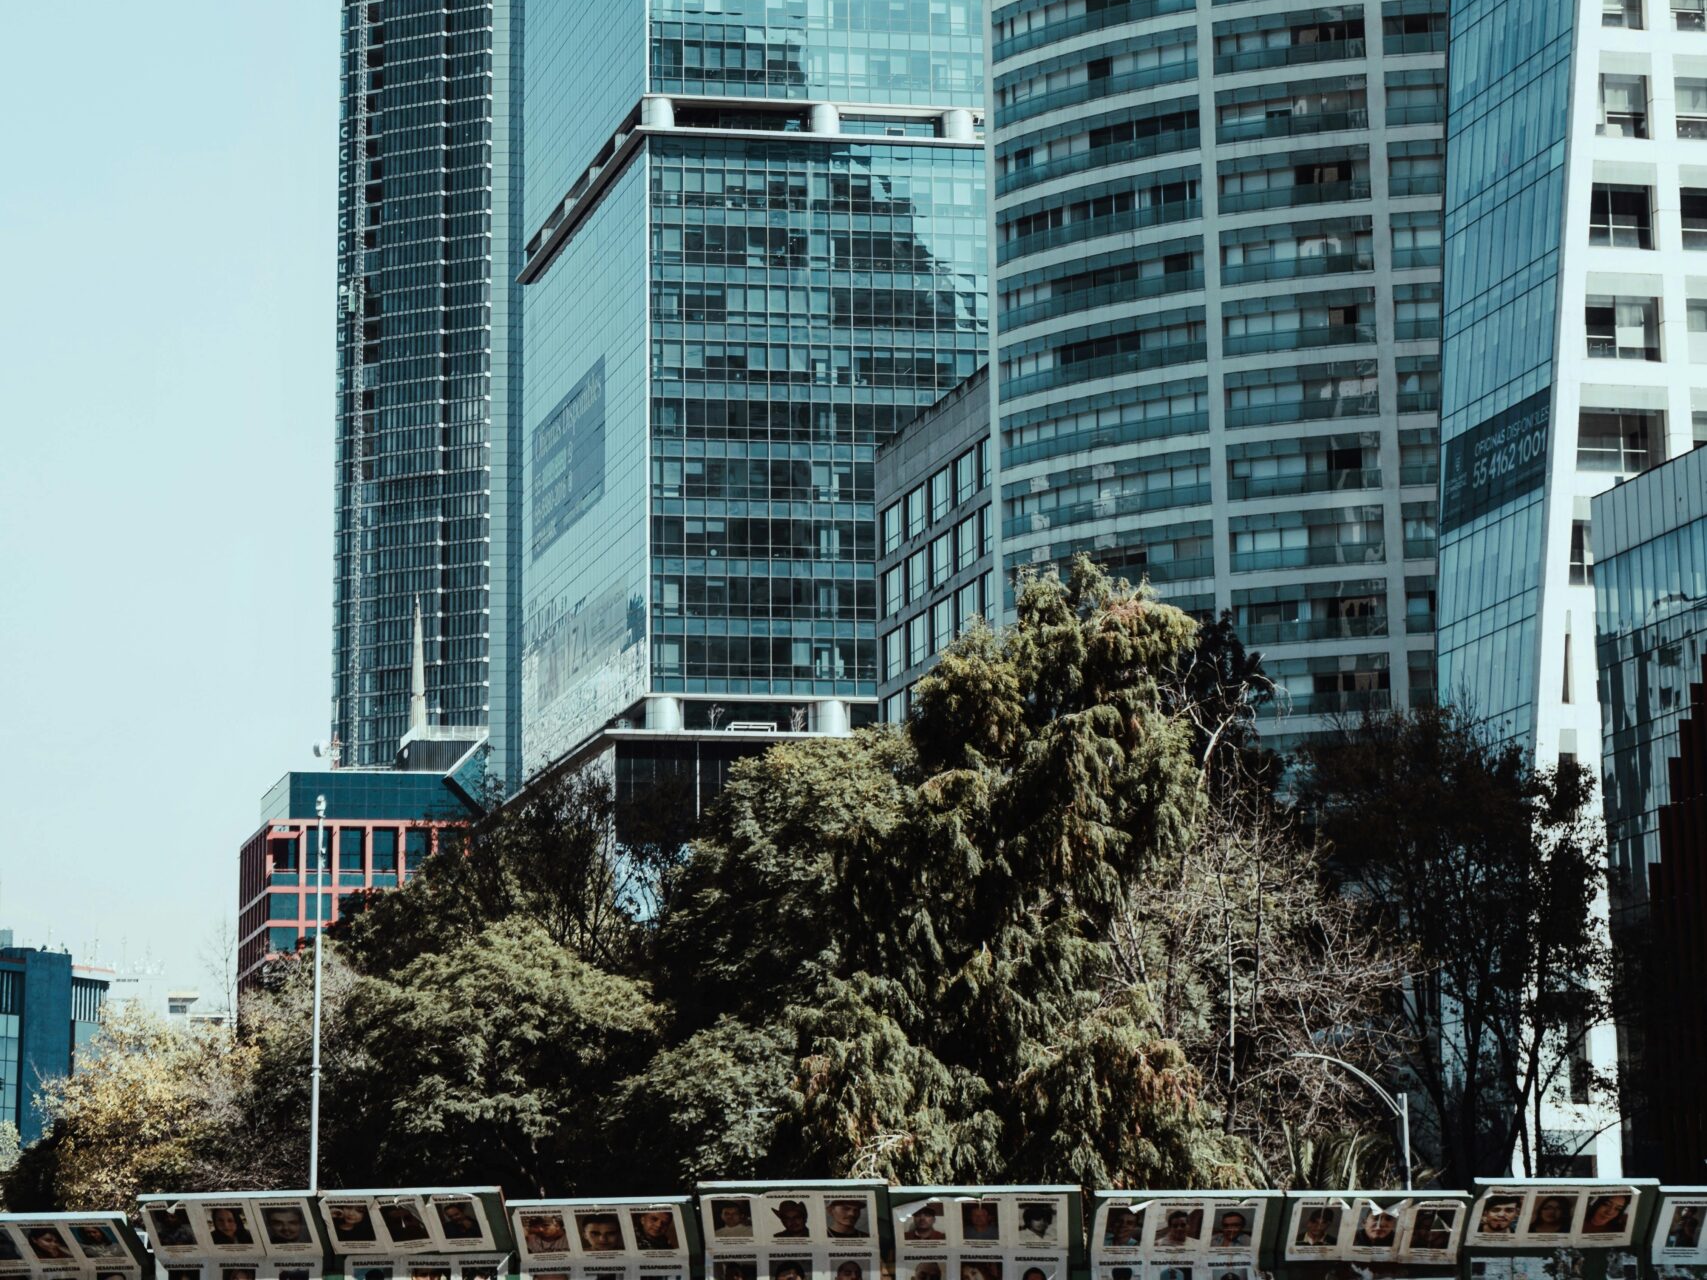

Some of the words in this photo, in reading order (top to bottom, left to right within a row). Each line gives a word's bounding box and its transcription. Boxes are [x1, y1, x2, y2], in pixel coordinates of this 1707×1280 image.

[1472, 457, 1487, 489] 55
[1488, 443, 1516, 480] 4162
[1517, 426, 1547, 466] 1001
[1474, 428, 1505, 457] OFICINAS
